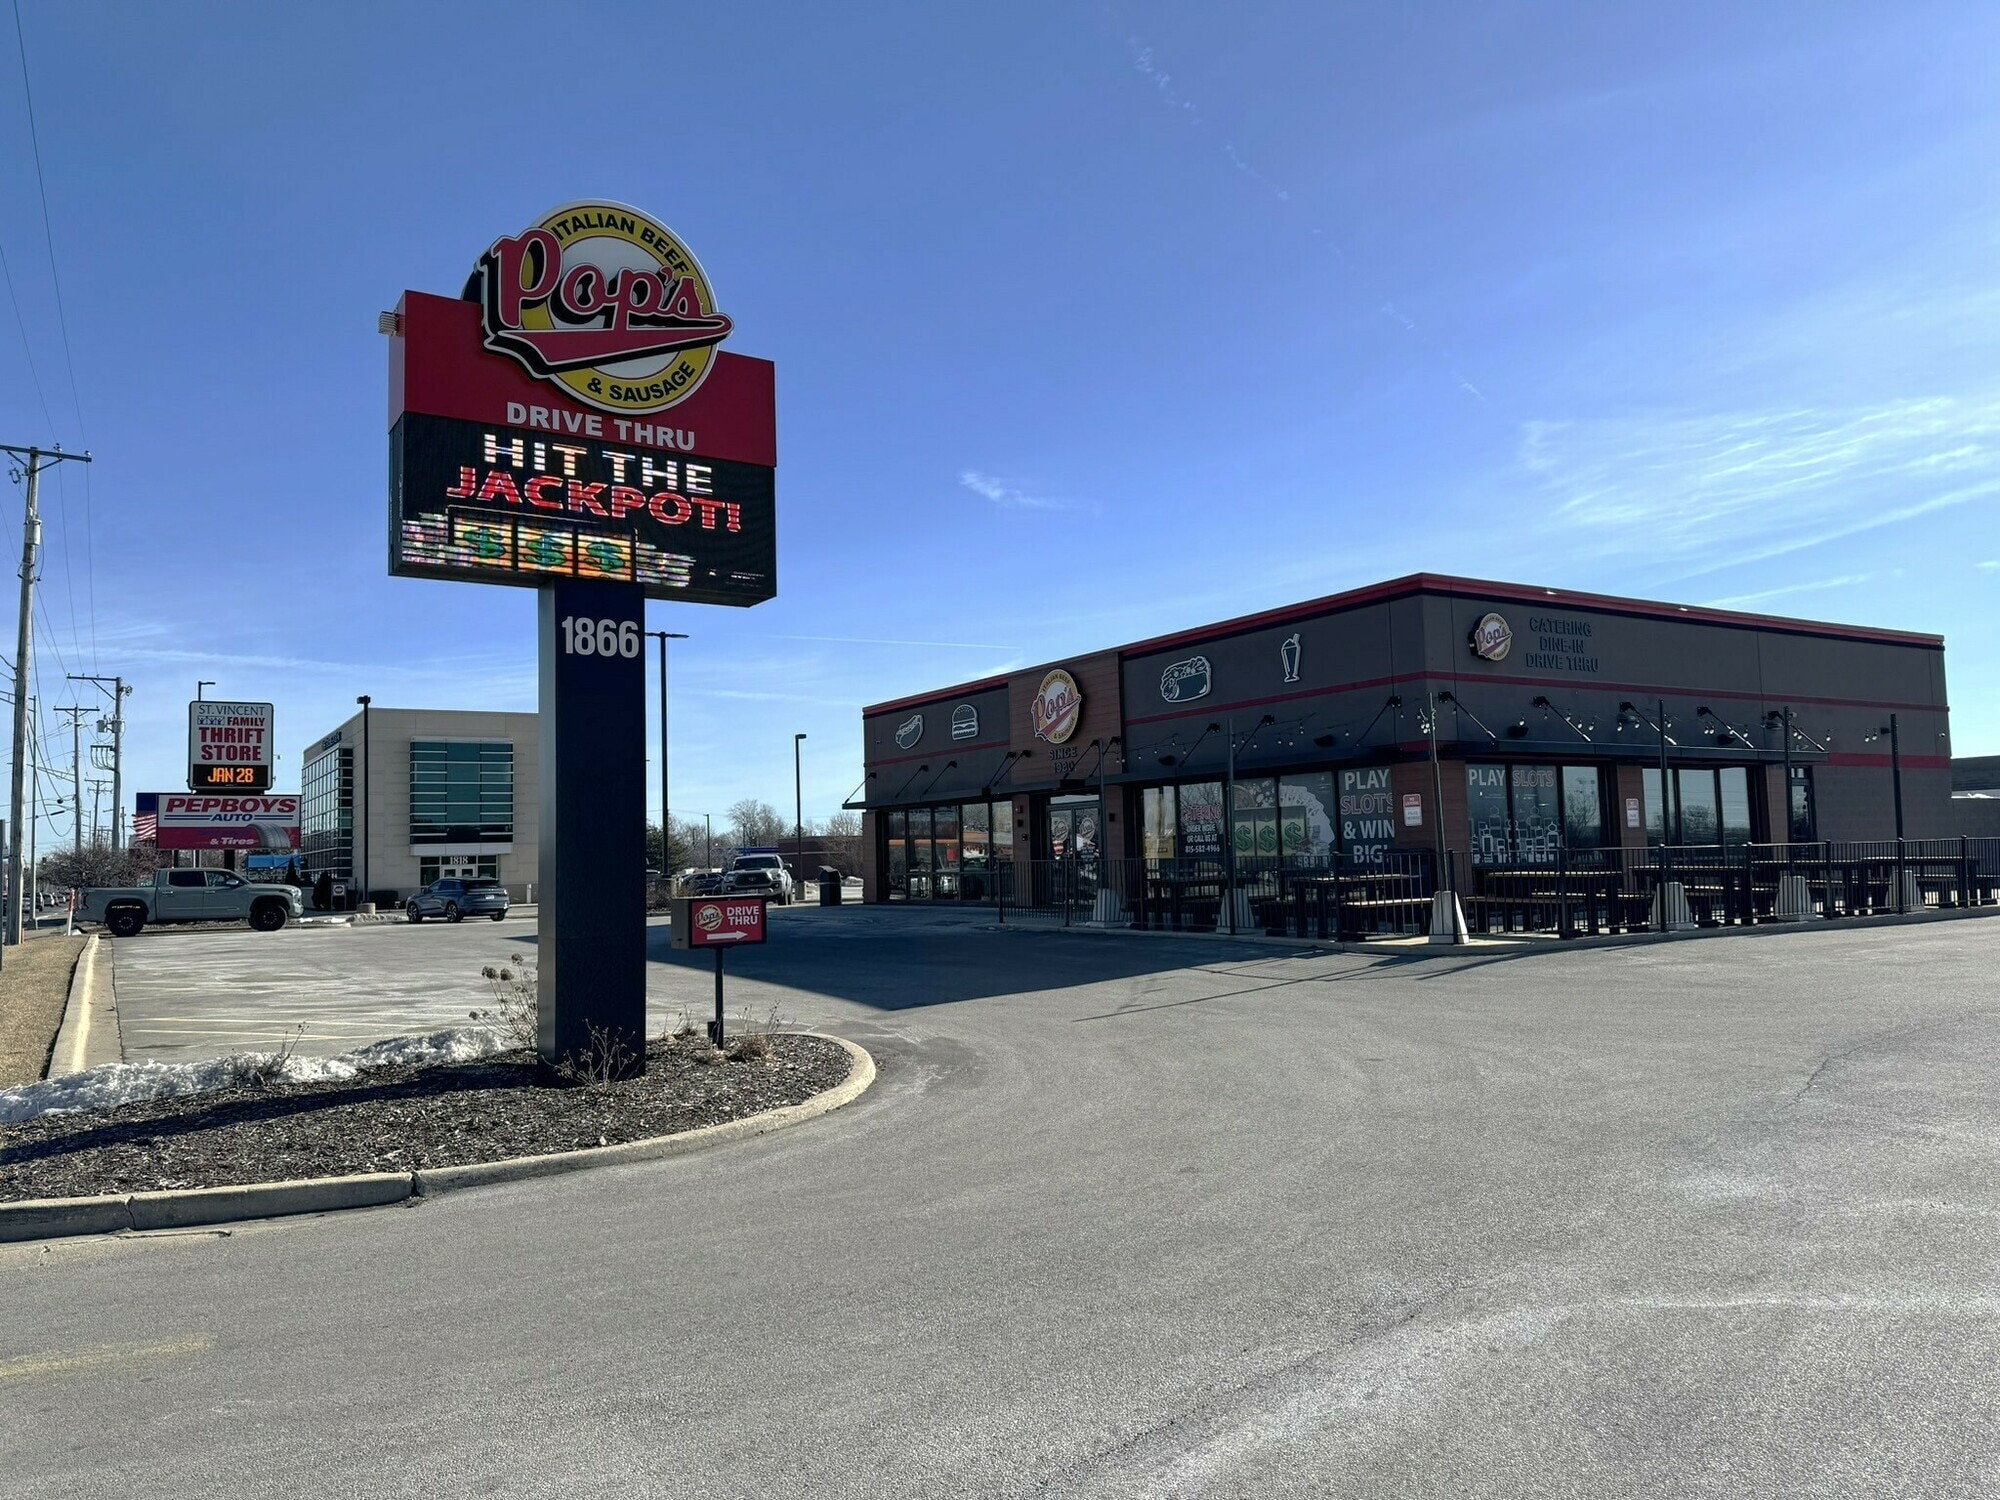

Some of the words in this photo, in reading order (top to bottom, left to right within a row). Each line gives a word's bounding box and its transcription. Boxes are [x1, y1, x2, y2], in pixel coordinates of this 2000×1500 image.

[552, 212, 636, 241] ITALIAN
[640, 227, 689, 274] BEEF
[489, 228, 718, 340] Pop's
[586, 376, 603, 395] &
[608, 361, 696, 403] SAUSAGE
[506, 401, 604, 437] DRIVE
[613, 418, 696, 451] THRU
[484, 433, 588, 476] HIT
[602, 450, 713, 494] THE
[446, 465, 742, 532] JACKPOT!
[1529, 616, 1592, 637] CATERING
[561, 615, 640, 659] 1866
[1540, 636, 1584, 655] DINE-IN
[1525, 653, 1563, 670] DRIVE
[1566, 655, 1599, 673] THRU
[198, 704, 214, 715] ST.
[216, 706, 265, 716] VINCENT
[227, 716, 265, 727] FAMILY
[198, 727, 265, 744] THRIFT
[200, 744, 262, 761] STORE
[1049, 746, 1078, 761] SINCE
[207, 767, 234, 783] JAN
[236, 767, 254, 783] 28
[1344, 768, 1390, 791] PLAY
[1468, 768, 1506, 787] PLAY
[1512, 769, 1554, 788] SLOTS
[165, 798, 296, 813] PEPBOYS
[211, 813, 253, 822] AUTO
[1343, 820, 1356, 840] &
[1359, 819, 1395, 839] WIN
[209, 837, 219, 846] &
[220, 836, 256, 846] Tires
[450, 855, 468, 865] 1818
[726, 905, 760, 917] DRIVE
[728, 915, 758, 926] THRU
